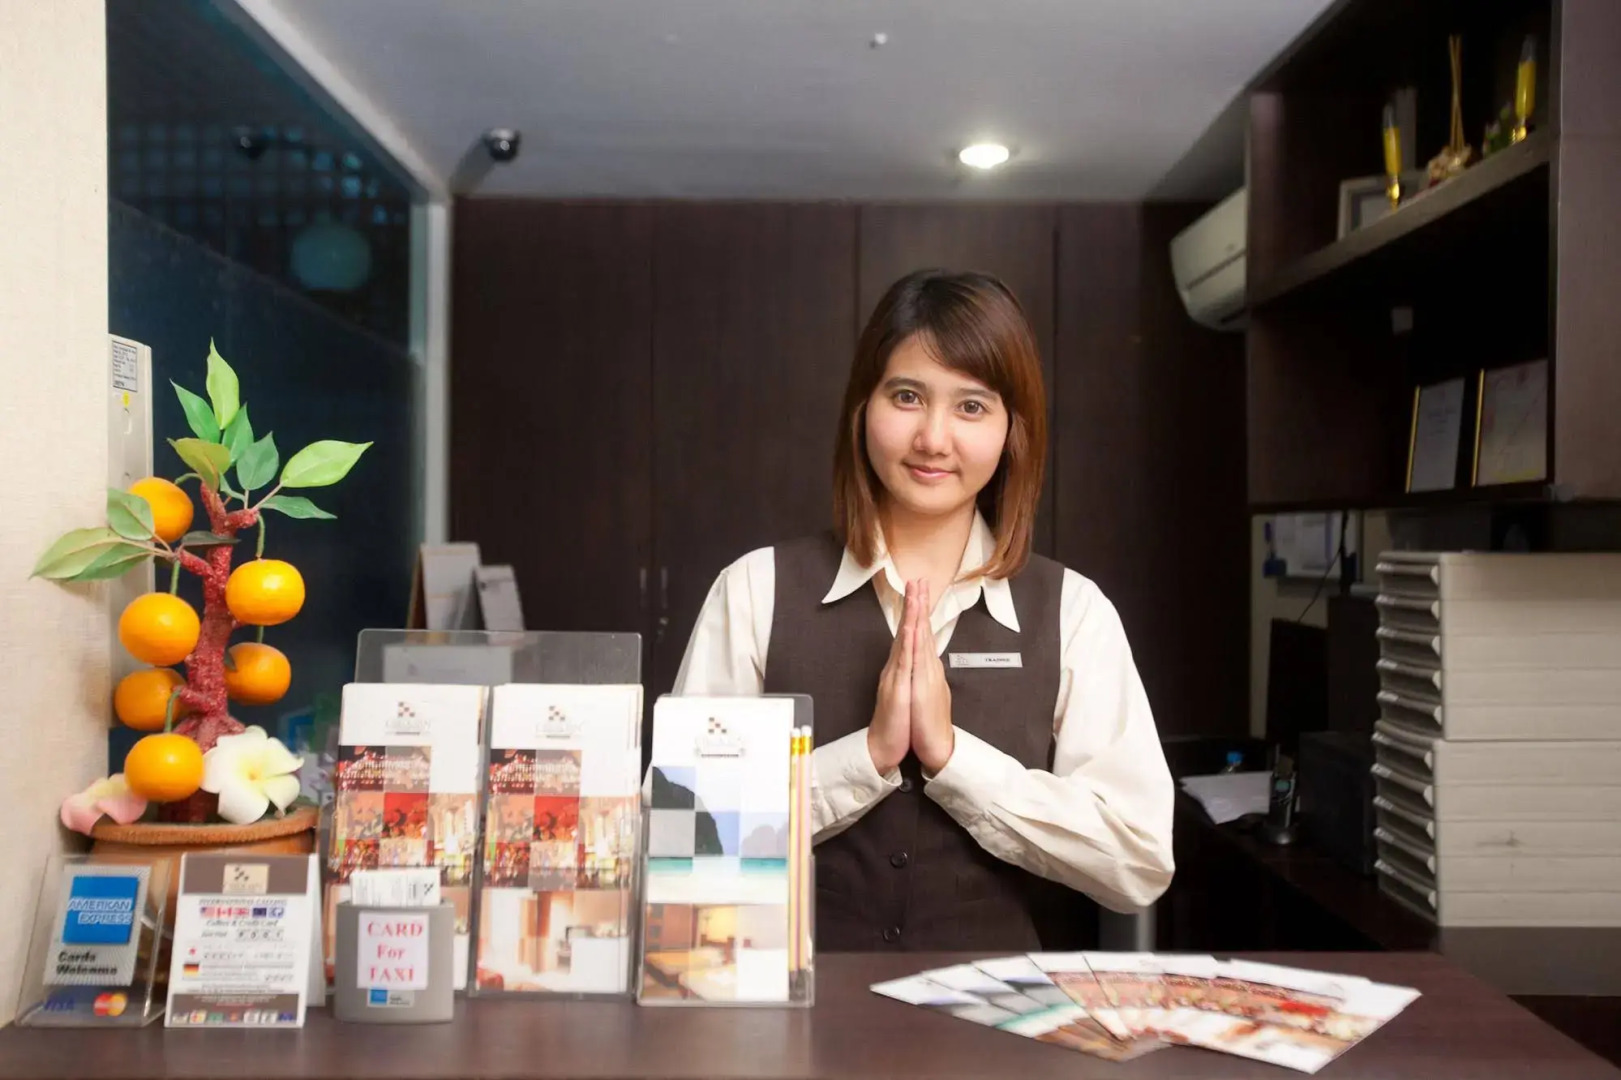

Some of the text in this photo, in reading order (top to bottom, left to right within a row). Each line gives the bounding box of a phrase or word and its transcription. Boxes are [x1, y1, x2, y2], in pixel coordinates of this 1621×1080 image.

[68, 898, 130, 910] AMERICAN
[79, 912, 132, 924] EXPRESS
[367, 921, 423, 937] CARD
[58, 951, 96, 962] Cards
[377, 943, 405, 959] For
[56, 964, 118, 975] Welcome
[369, 966, 414, 981] TAXI
